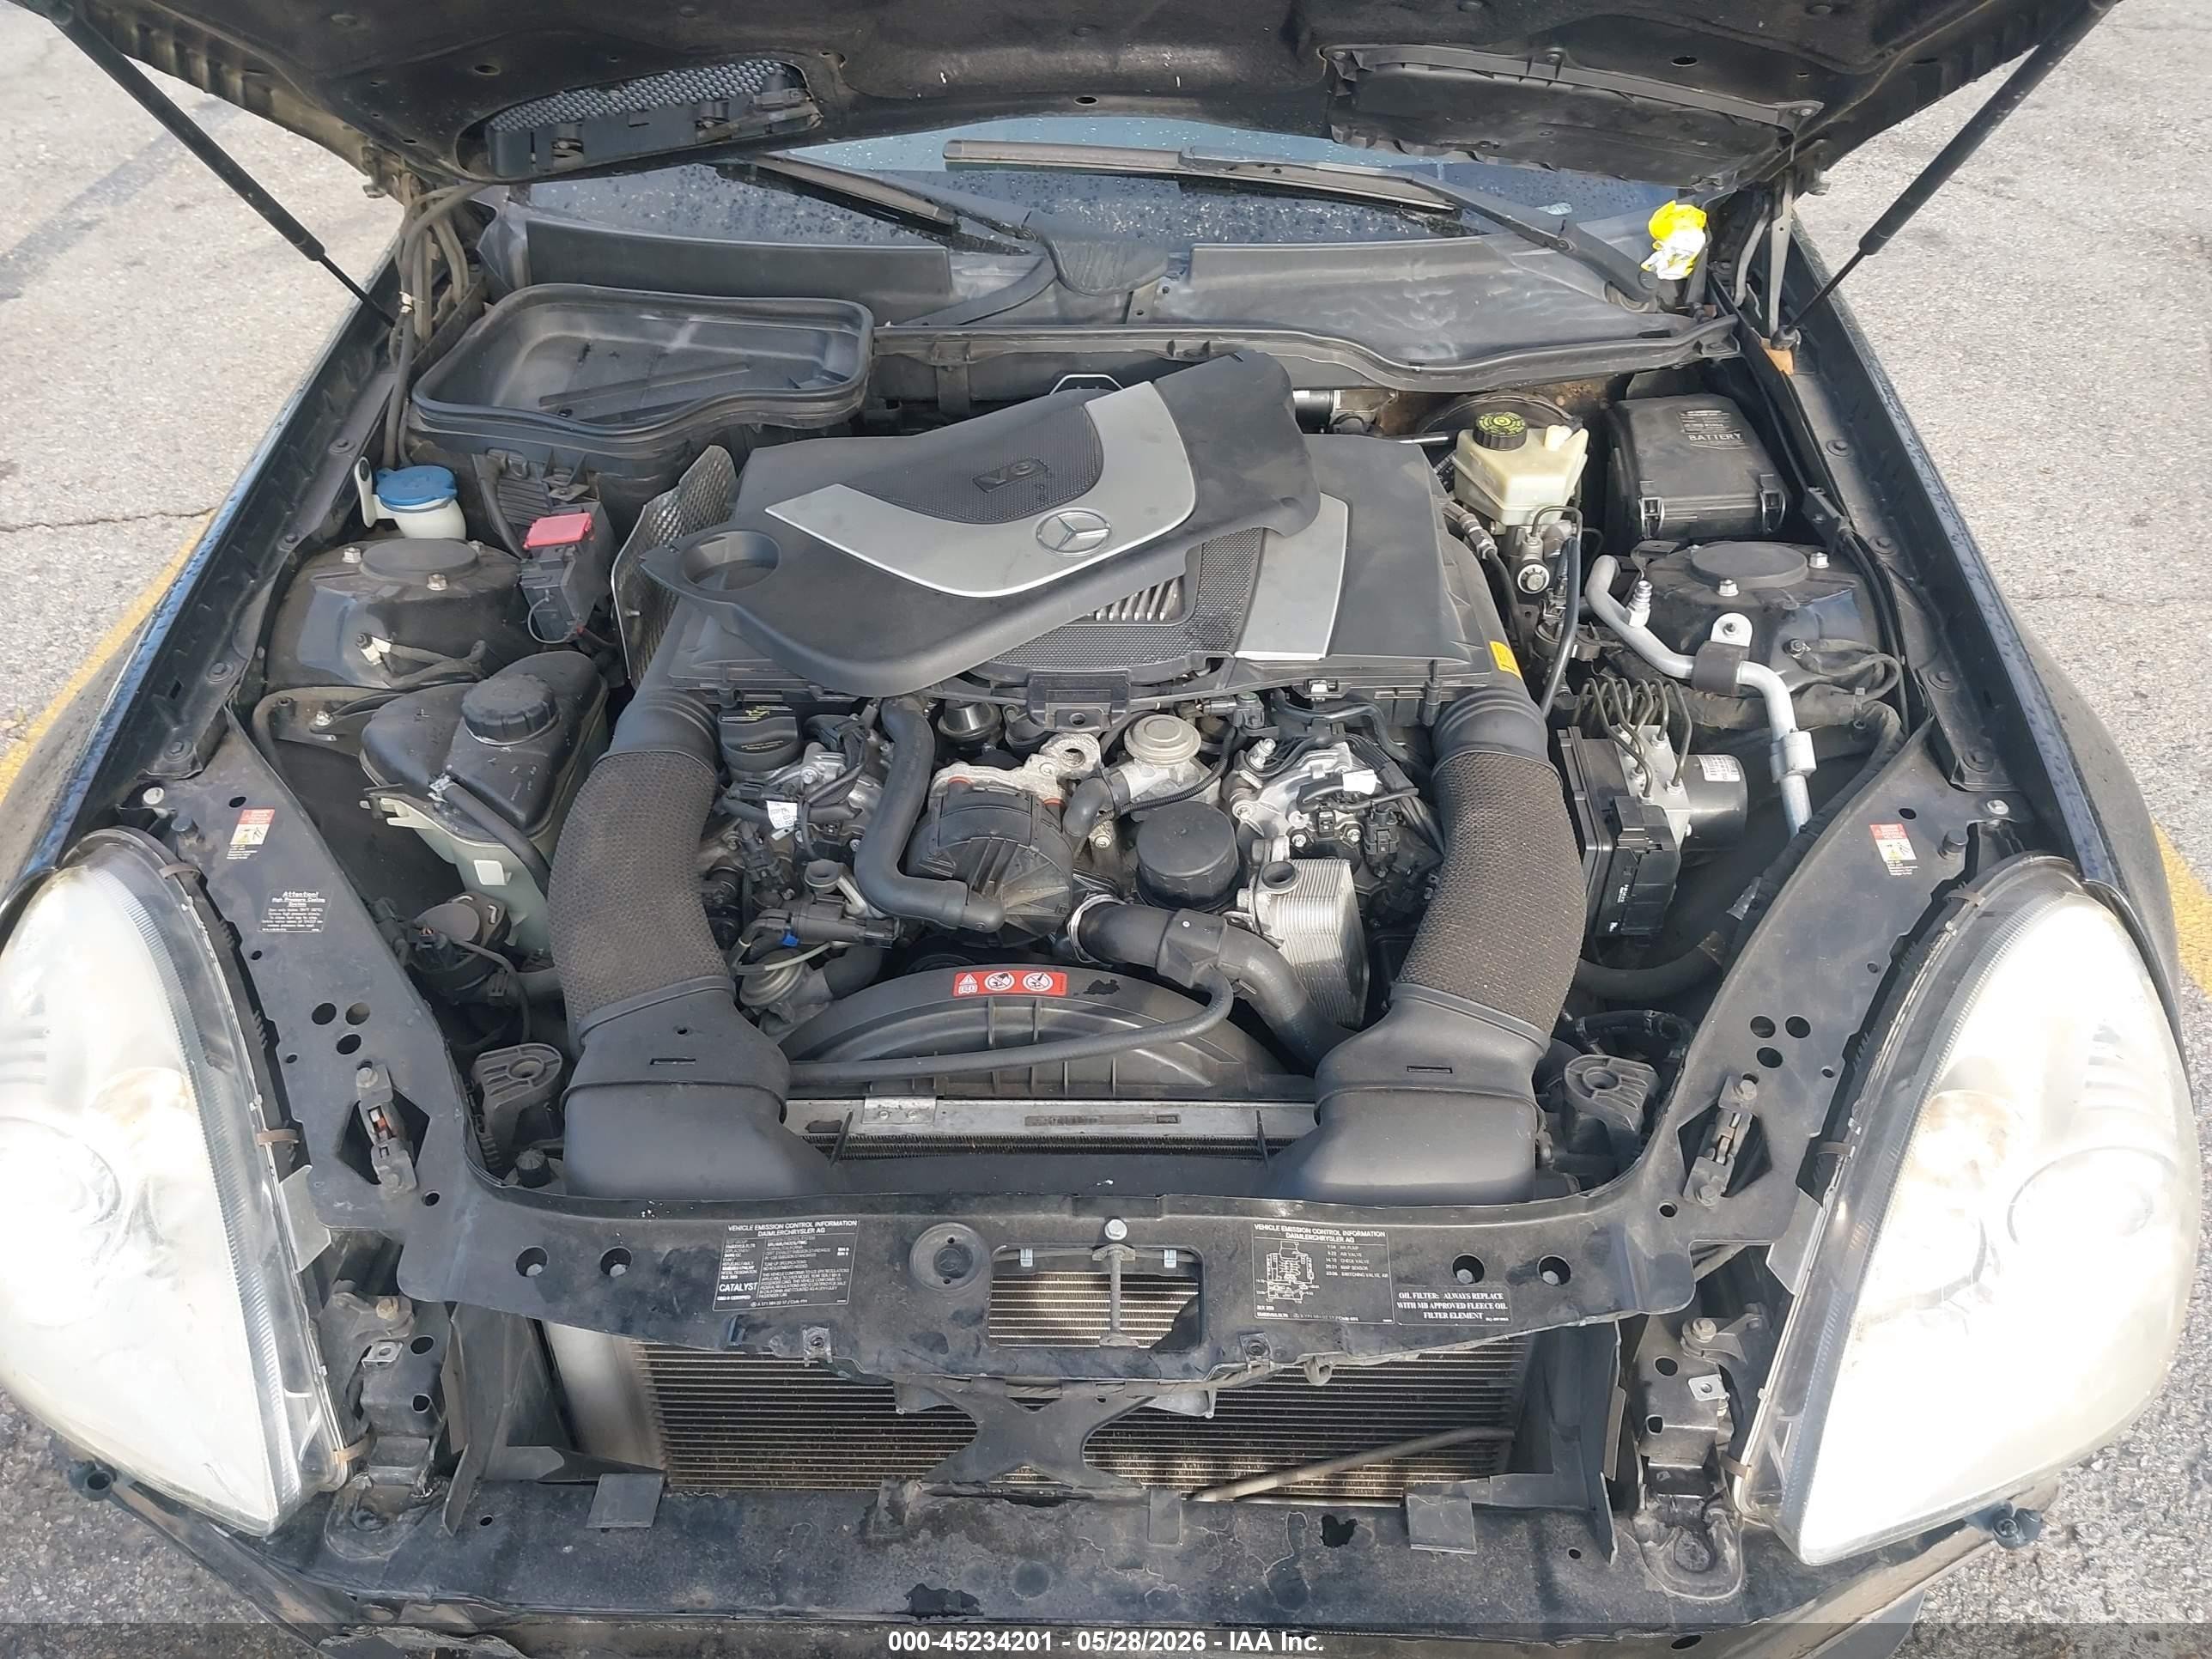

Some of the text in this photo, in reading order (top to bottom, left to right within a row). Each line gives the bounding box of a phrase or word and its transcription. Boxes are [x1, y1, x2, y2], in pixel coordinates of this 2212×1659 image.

[1688, 432, 1741, 441] BATTERY
[757, 1228, 815, 1237] DAIMLERCHRYSLER
[1281, 1225, 1311, 1234] EMISSION
[1312, 1228, 1341, 1237] CONTROL
[1285, 1232, 1344, 1243] DAIMLERCHRYSLER
[719, 1282, 758, 1291] CATALYST
